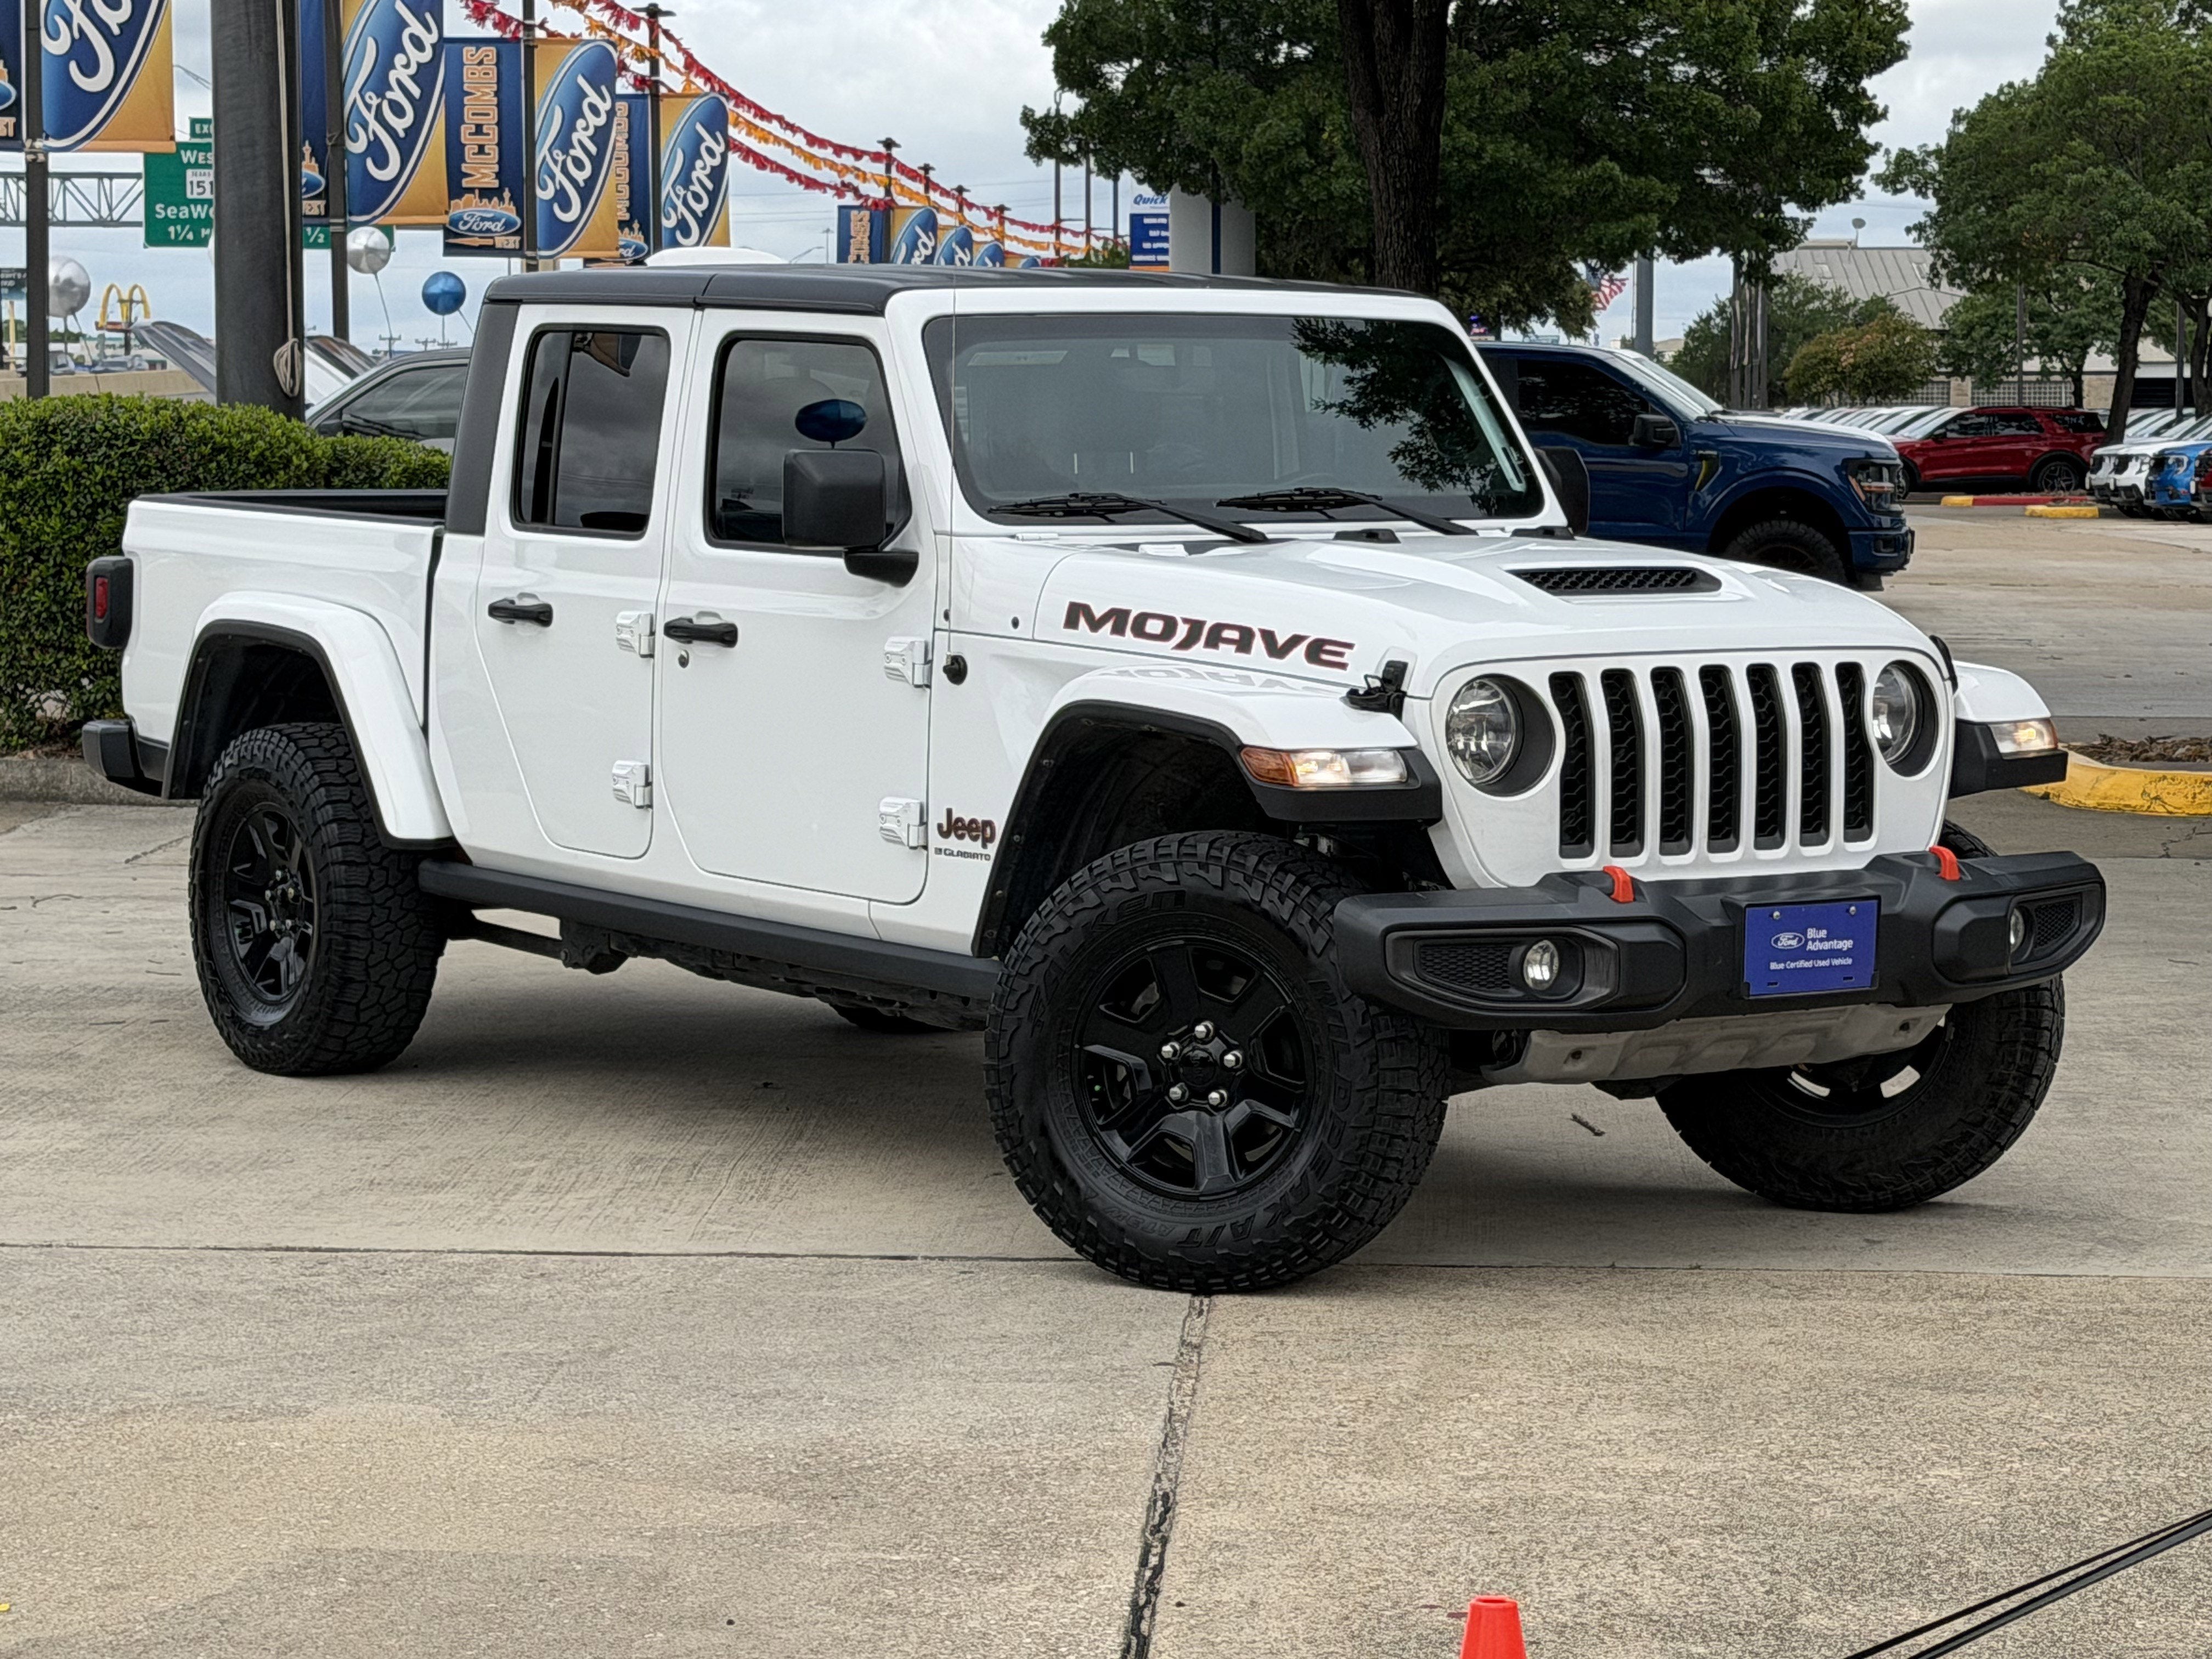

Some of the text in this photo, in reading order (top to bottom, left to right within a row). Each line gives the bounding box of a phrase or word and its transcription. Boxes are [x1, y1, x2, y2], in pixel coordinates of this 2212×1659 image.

[345, 0, 438, 181] Ford
[536, 74, 612, 223] Ford
[662, 122, 725, 247] Ford
[1133, 194, 1168, 205] Quick
[458, 211, 506, 232] Ford
[1063, 601, 1356, 671] MOJAVE
[937, 808, 996, 849] Jeep
[1778, 935, 1799, 946] Ford
[1807, 928, 1827, 939] Blue
[1806, 939, 1854, 951] Advantage
[1786, 960, 1813, 969] Certified
